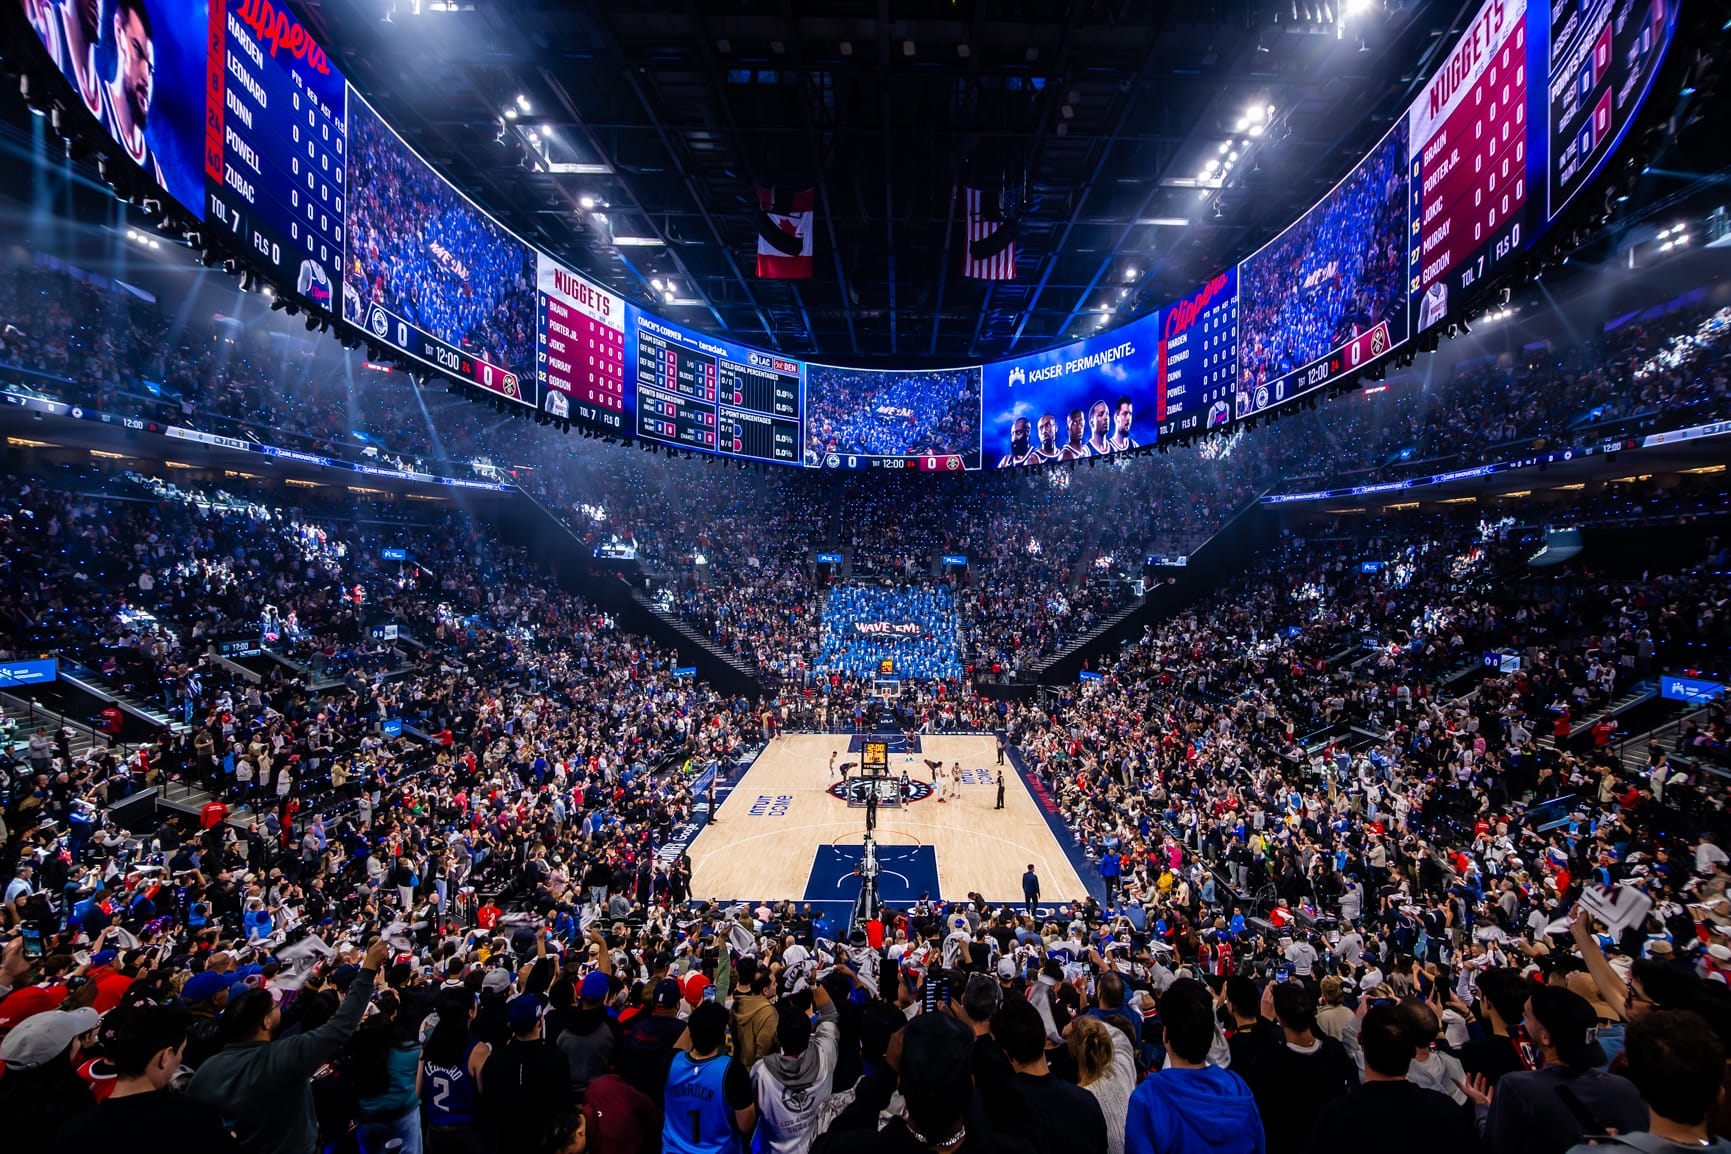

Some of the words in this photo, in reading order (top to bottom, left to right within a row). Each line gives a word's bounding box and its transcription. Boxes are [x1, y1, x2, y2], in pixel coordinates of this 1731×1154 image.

[1430, 0, 1504, 121] NUGGETS
[228, 12, 263, 70] HARDEN
[293, 92, 299, 110] 0
[309, 110, 314, 127] 0
[322, 124, 328, 140] 0
[336, 138, 342, 154] 0
[1414, 161, 1419, 177] 0
[1424, 130, 1446, 167] BRAUN
[1476, 86, 1481, 105] 0
[1490, 67, 1496, 86] 0
[1503, 48, 1509, 68] 0
[1517, 27, 1523, 48] 0
[228, 50, 266, 108] LEONARD
[293, 124, 298, 142] 0
[308, 141, 314, 158] 0
[322, 154, 328, 170] 0
[336, 168, 342, 183] 0
[227, 88, 252, 129] DUNN
[292, 157, 298, 174] 0
[308, 172, 314, 189] 0
[322, 184, 327, 200] 0
[336, 197, 341, 212] 0
[226, 126, 261, 174] POWELL
[292, 190, 298, 207] 0
[308, 204, 313, 220] 0
[322, 215, 327, 231] 0
[336, 226, 341, 241] 0
[1414, 191, 1418, 204] 1
[1424, 160, 1449, 196] PORTER
[1449, 148, 1461, 171] JR.
[207, 146, 220, 172] 40
[225, 163, 254, 204] ZUBAC
[292, 222, 297, 239] 0
[308, 235, 313, 251] 0
[321, 245, 326, 261] 0
[335, 256, 340, 271] 0
[1412, 218, 1420, 235] 15
[1424, 196, 1443, 225] JOKIC
[211, 194, 228, 224] TOL
[232, 209, 240, 233] 7
[254, 231, 269, 256] FLS
[272, 243, 280, 265] 0
[1412, 246, 1420, 265] 27
[1423, 218, 1451, 255] MURRAY
[1462, 269, 1475, 288] TOL
[1478, 255, 1484, 278] 7
[1496, 235, 1509, 261] FLS
[1512, 223, 1520, 248] 0
[1411, 275, 1420, 294] 32
[1423, 250, 1450, 284] GORDON
[554, 268, 610, 316] NUGGETS
[550, 301, 568, 319] BRAUN
[1165, 274, 1228, 338] Clippers
[550, 320, 570, 338] PORTER
[570, 330, 578, 342] JR.
[660, 326, 682, 342] CORNER
[1168, 333, 1187, 350] HARDEN
[398, 322, 408, 347] 0
[436, 346, 460, 370] 12:00
[462, 362, 471, 374] 24
[484, 366, 492, 386] 0
[549, 338, 566, 353] JOKIC
[549, 356, 572, 374] MURRAY
[759, 356, 771, 366] LAC
[784, 363, 797, 372] DEN
[1168, 350, 1189, 366] LEONARD
[1029, 365, 1062, 383] KAISER
[1168, 370, 1182, 383] DUNN
[1276, 380, 1284, 400] 0
[1308, 362, 1329, 385] 12:00
[1352, 341, 1360, 365] 0
[549, 375, 572, 392] GORDON
[1167, 385, 1186, 398] POWELL
[591, 409, 596, 420] 7
[614, 416, 619, 427] 0
[1167, 402, 1183, 415] ZUBAC
[123, 418, 143, 429] 12:00
[1170, 423, 1175, 433] 7
[1192, 416, 1197, 427] 0
[1603, 442, 1621, 453] 12:00
[848, 456, 856, 468] 0
[883, 459, 904, 468] 12:00
[928, 457, 936, 469] 0
[855, 622, 890, 633] WAVE
[433, 1076, 450, 1112] 2
[687, 1109, 700, 1144] 1
